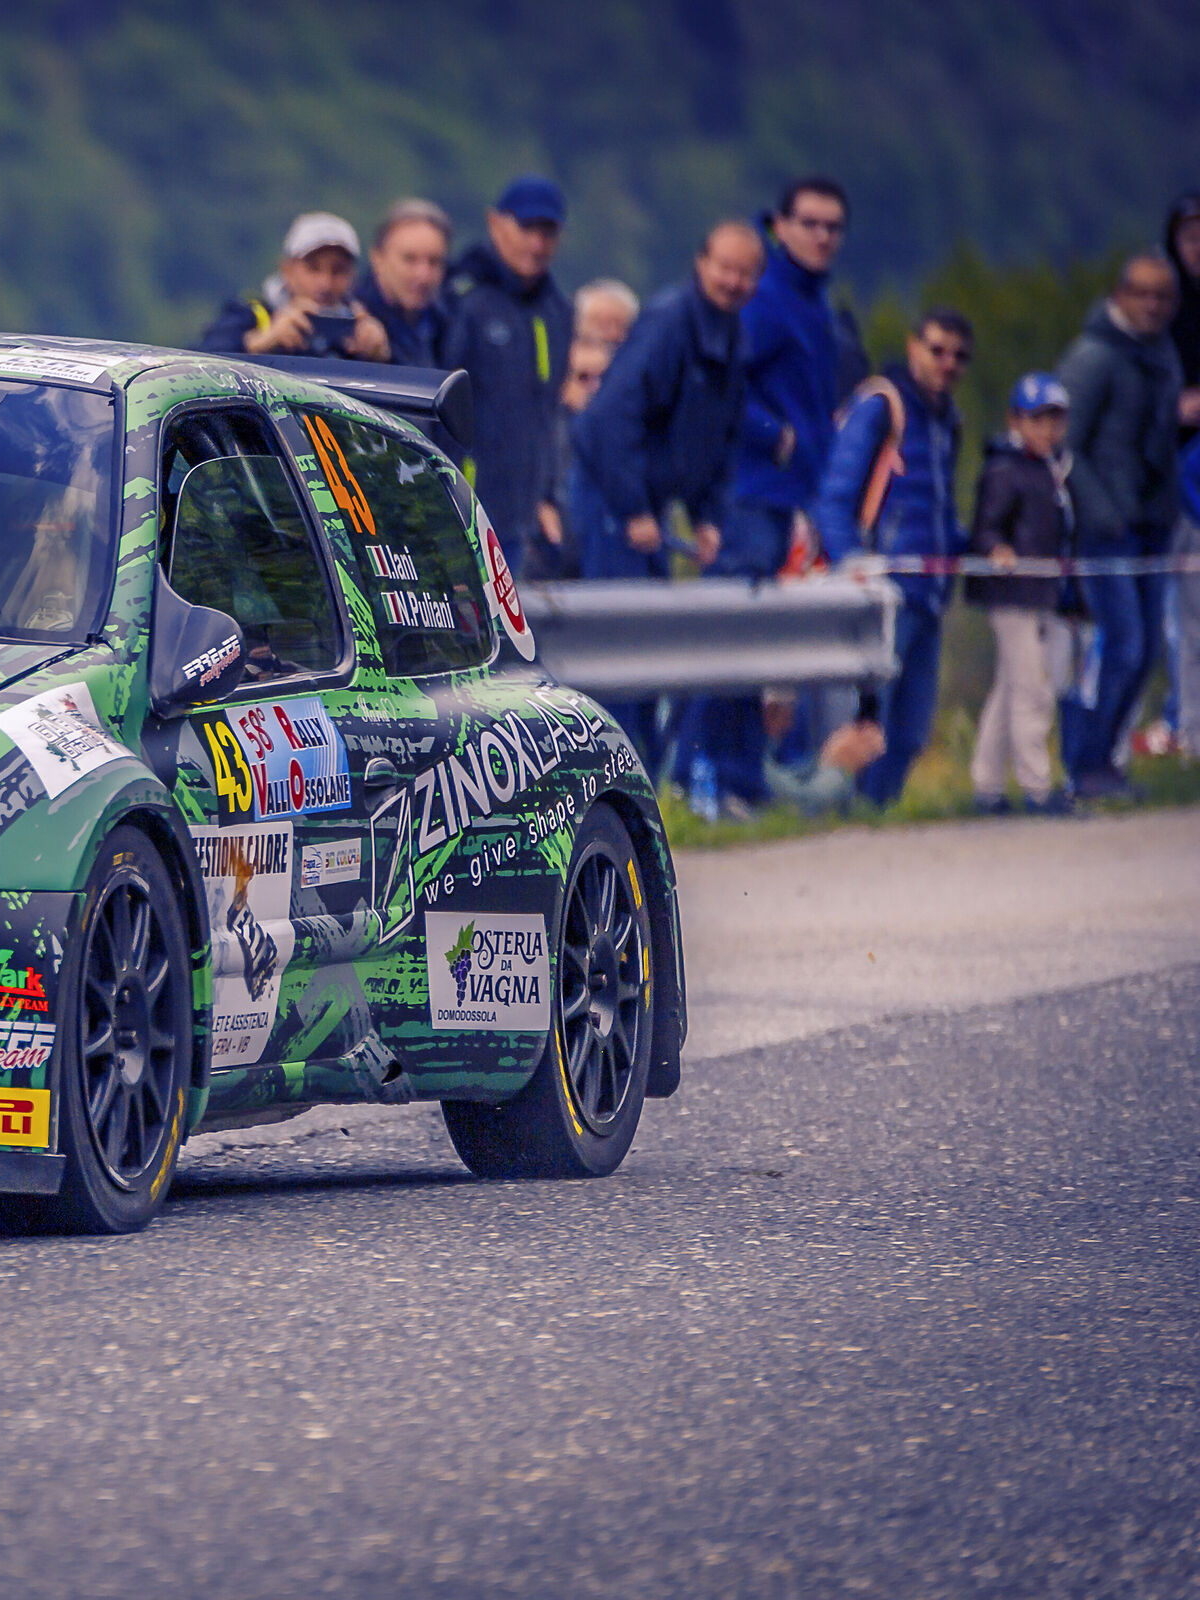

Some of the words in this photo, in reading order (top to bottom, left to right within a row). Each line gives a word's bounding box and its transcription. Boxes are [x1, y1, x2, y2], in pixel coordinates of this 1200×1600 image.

[303, 414, 376, 536] 43
[271, 703, 329, 752] RALLY
[202, 720, 253, 814] 43
[288, 757, 350, 813] OSSOLANE
[423, 872, 455, 905] we
[469, 835, 517, 887] give
[528, 793, 576, 844] shape
[581, 775, 598, 802] to
[471, 929, 544, 970] OSTERIA
[500, 959, 513, 972] DA
[18, 997, 50, 1012] TEAM
[469, 973, 541, 1008] VAGNA
[437, 1009, 497, 1023] DOMODOSSOLA
